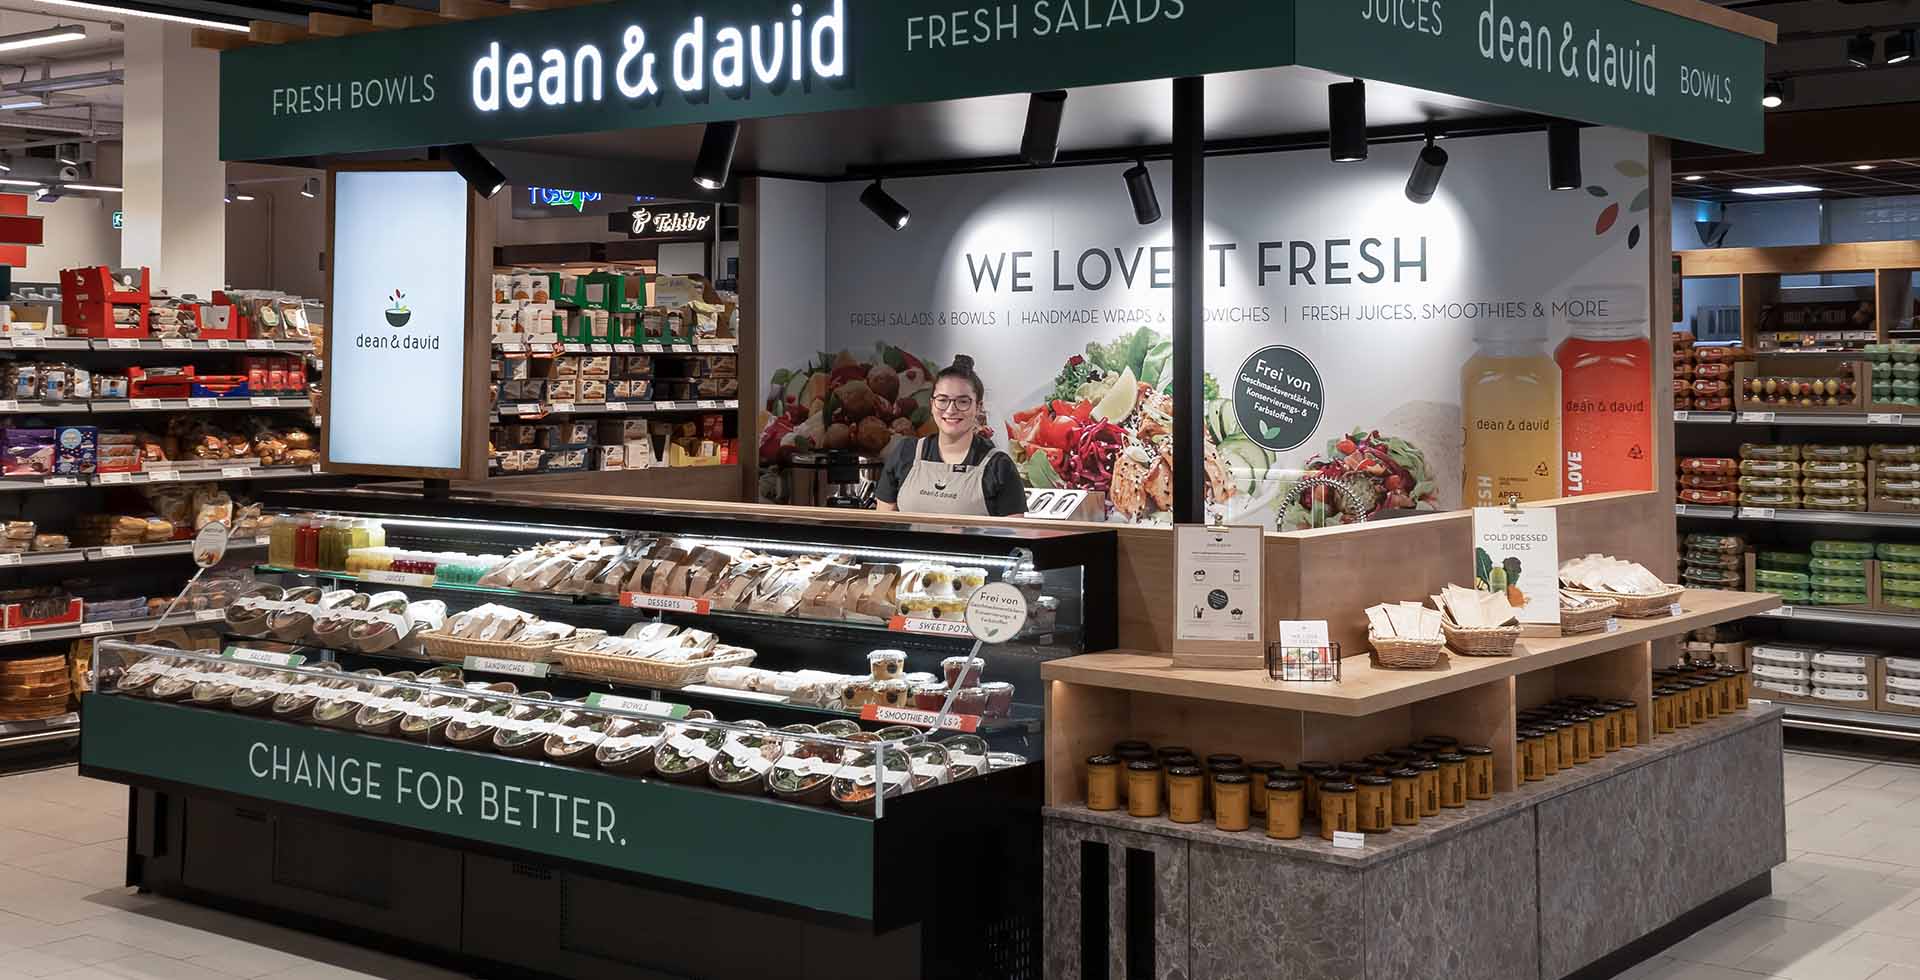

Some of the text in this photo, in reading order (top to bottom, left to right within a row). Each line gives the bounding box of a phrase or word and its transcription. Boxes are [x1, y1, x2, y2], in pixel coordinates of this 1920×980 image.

[907, 0, 1185, 51] FRESH SALADS
[1362, 0, 1442, 36] JUICES
[472, 0, 844, 112] dean & david
[1478, 0, 1656, 96] dean & david
[272, 73, 435, 116] FRESH BOWLS
[1680, 65, 1732, 105] BOWLS
[653, 211, 711, 233] Tchibo
[966, 236, 1427, 293] WE LOVE T FRESH
[850, 312, 885, 326] FRESH
[887, 311, 935, 326] SALADS
[937, 311, 947, 326] &
[951, 311, 996, 326] BOWLS
[1022, 309, 1099, 325] HANDMADE
[1103, 308, 1151, 324] WRAPS
[1203, 306, 1270, 322] DWICHES
[1302, 305, 1350, 321] FRESH
[1355, 303, 1417, 321] JUICES,
[1422, 302, 1527, 319] SMOOTHIES
[1532, 302, 1545, 317] &
[1551, 300, 1608, 318] MORE
[356, 333, 440, 350] dean & david
[1255, 359, 1311, 392] Frei von
[1254, 402, 1293, 424] Farbstoffen
[1567, 400, 1595, 412] dean
[1609, 400, 1644, 412] david
[1476, 419, 1550, 431] dean & david
[1567, 451, 1584, 491] LOVE
[1483, 533, 1549, 542] COLD PRESSED
[1501, 543, 1531, 551] JUICES
[648, 598, 681, 609] DESSERTS
[980, 592, 999, 603] Frei
[919, 622, 969, 634] SWEET POTS
[885, 711, 922, 723] SMOOTHIE
[248, 742, 627, 846] CHANGE FOR BETTER.
